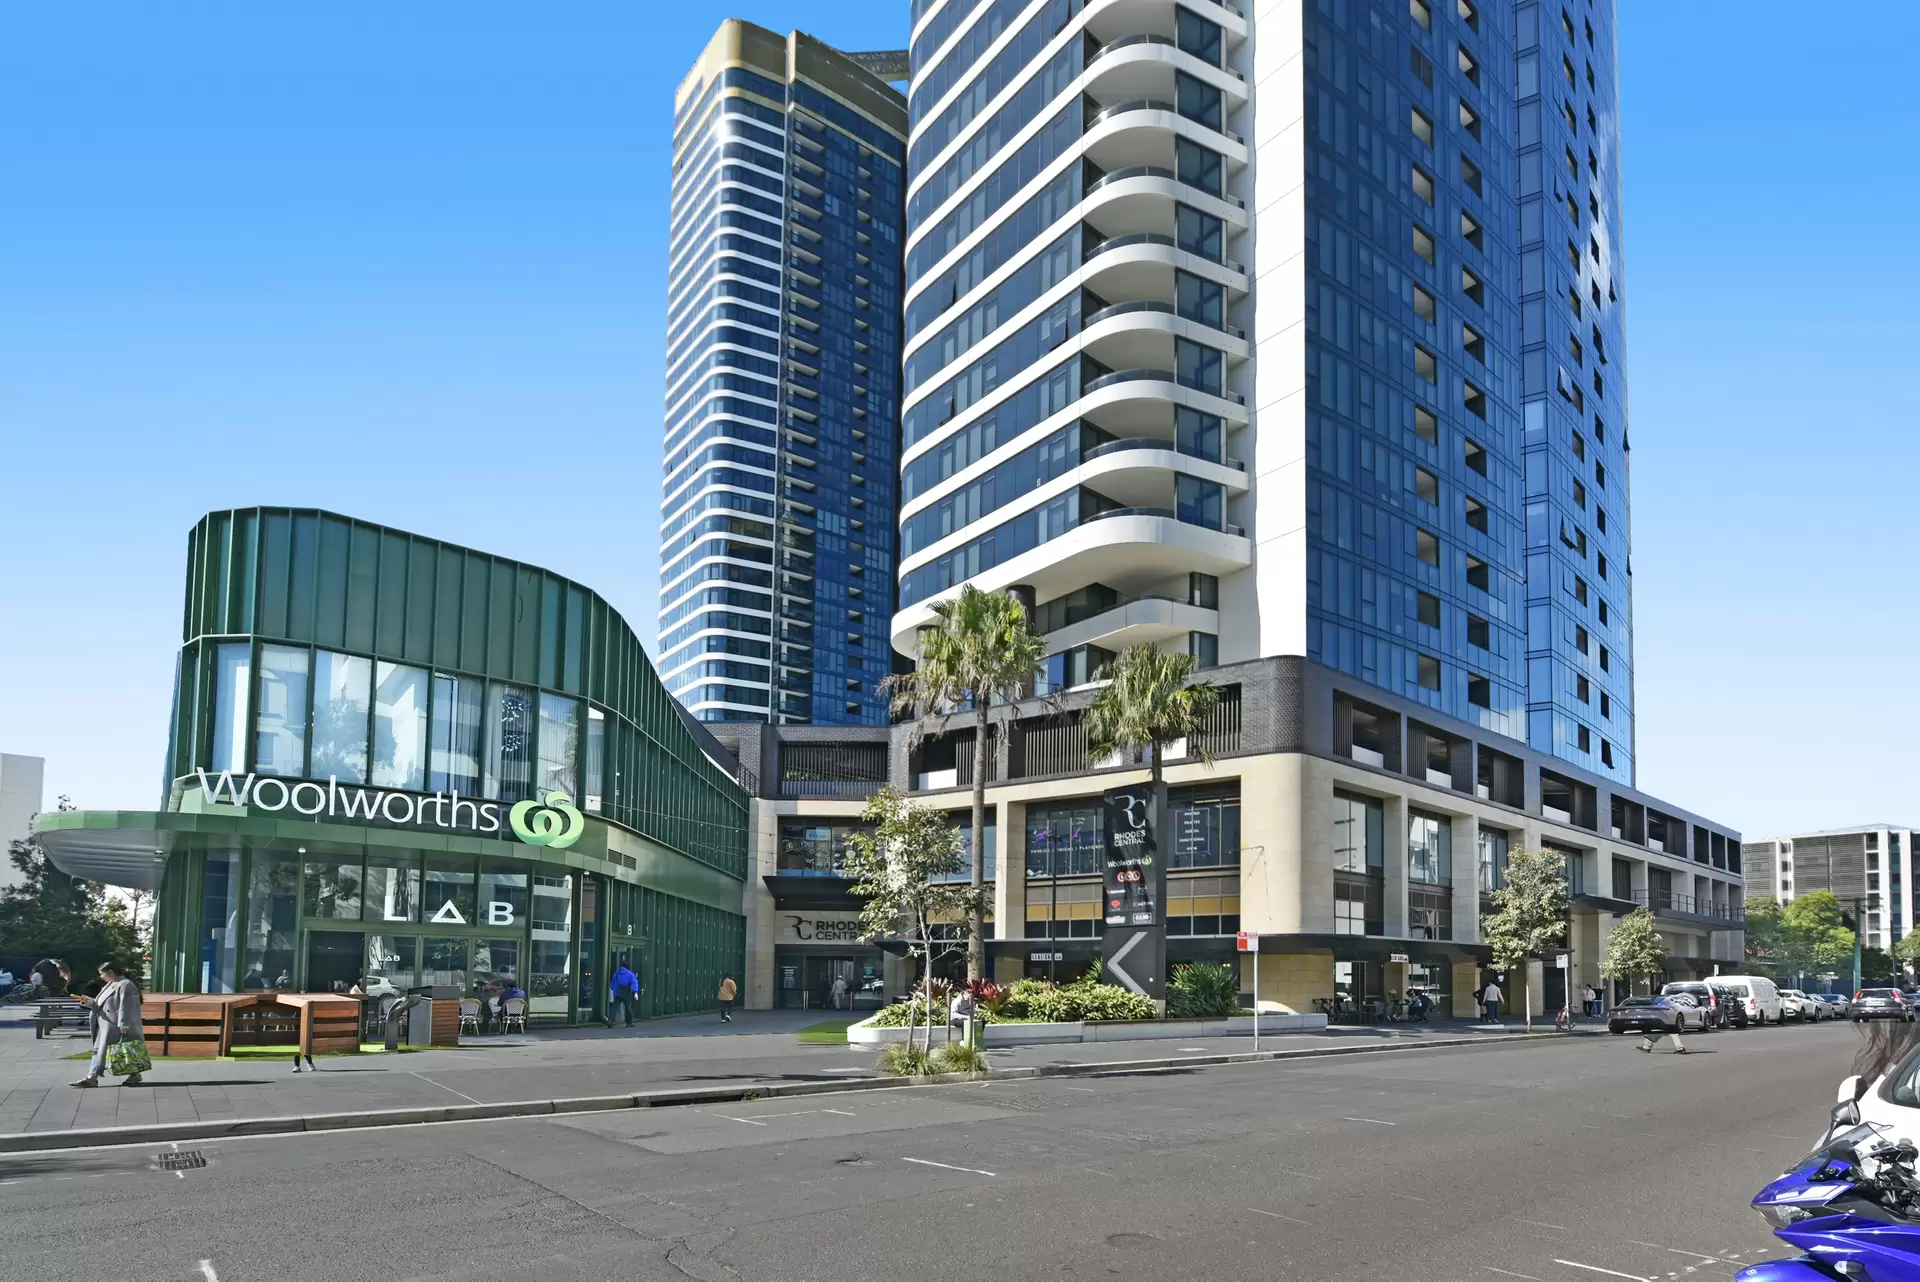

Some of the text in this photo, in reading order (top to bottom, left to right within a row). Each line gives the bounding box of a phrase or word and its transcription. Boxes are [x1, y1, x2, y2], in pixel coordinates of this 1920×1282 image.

[196, 767, 500, 832] Woolworths
[1114, 829, 1146, 841] RHODES
[1113, 837, 1146, 847] CENTRAL
[1107, 857, 1142, 869] Woolworths
[816, 930, 864, 941] CENTR
